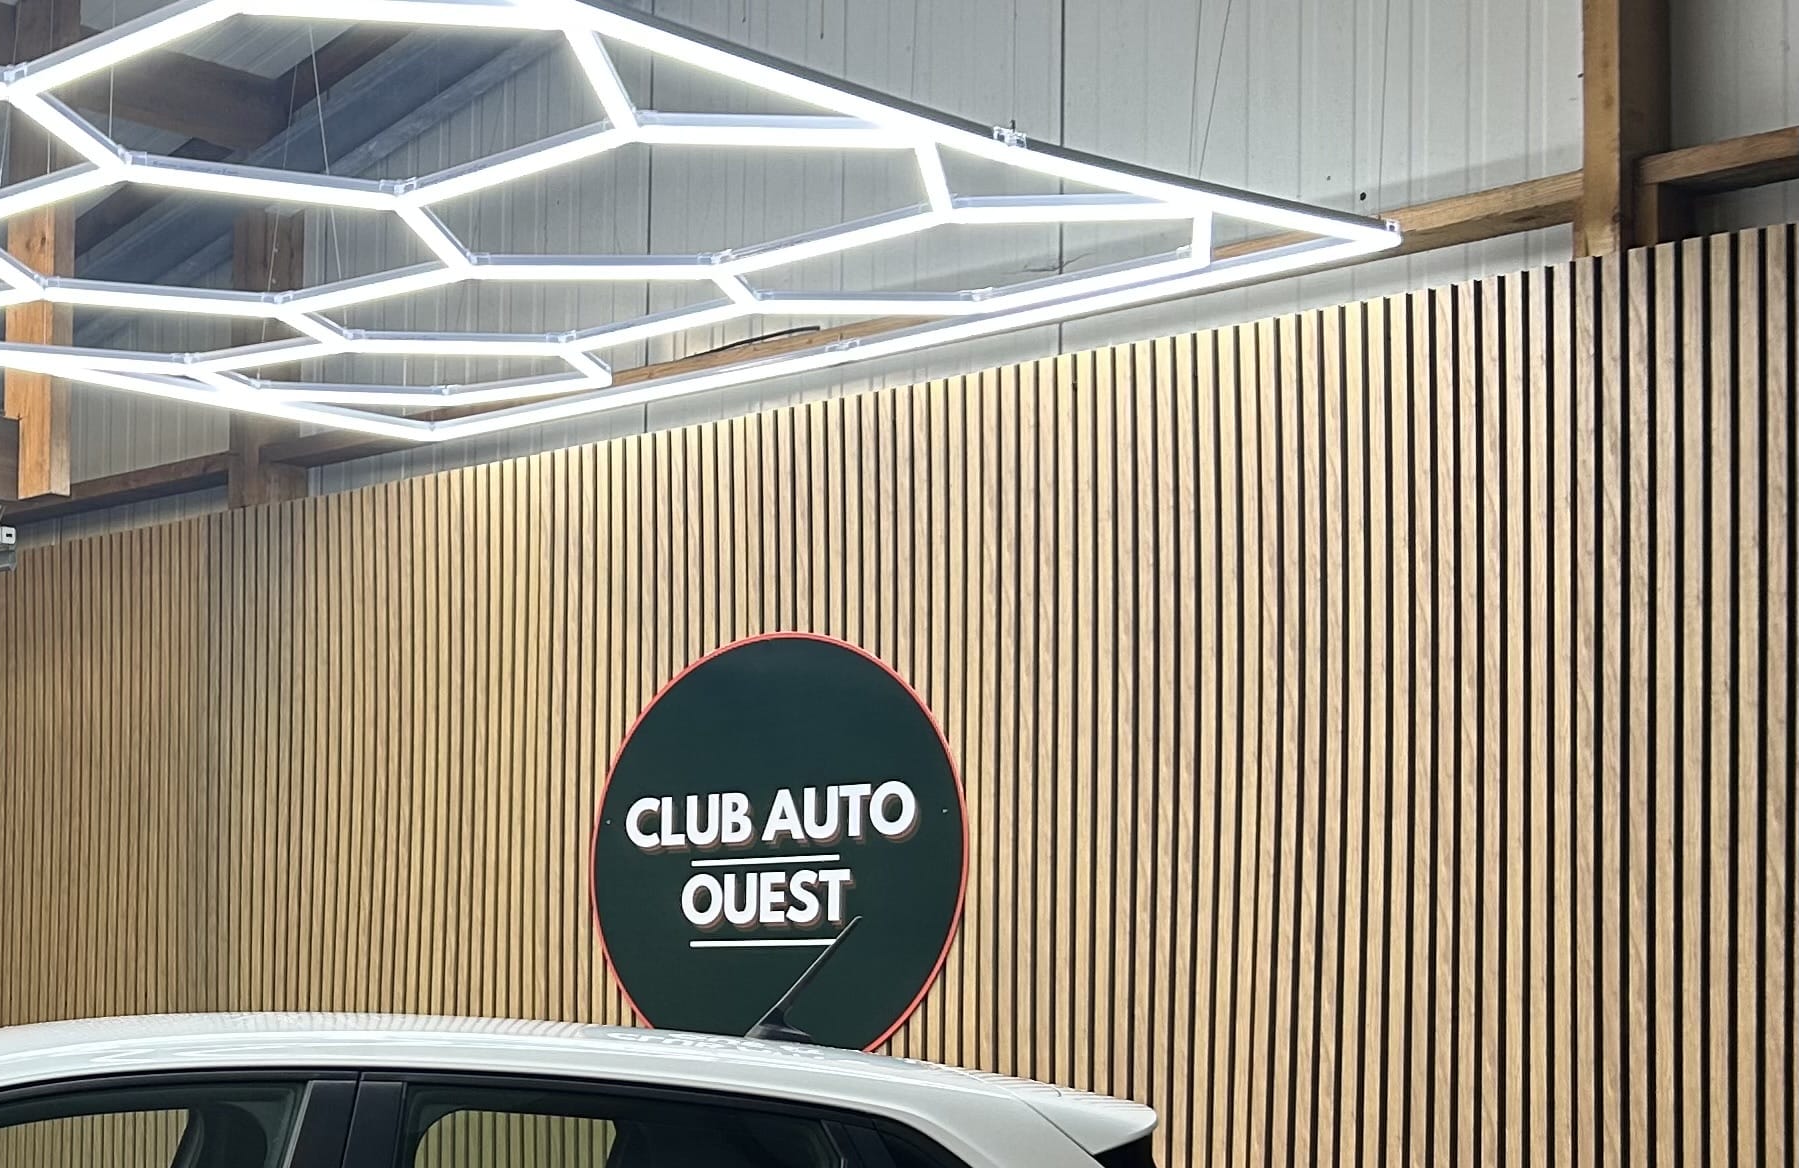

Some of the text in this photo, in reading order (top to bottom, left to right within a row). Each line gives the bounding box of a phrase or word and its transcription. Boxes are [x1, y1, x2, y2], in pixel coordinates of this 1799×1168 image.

[625, 780, 918, 851] CLUB AUTO
[681, 868, 853, 928] OUEST
